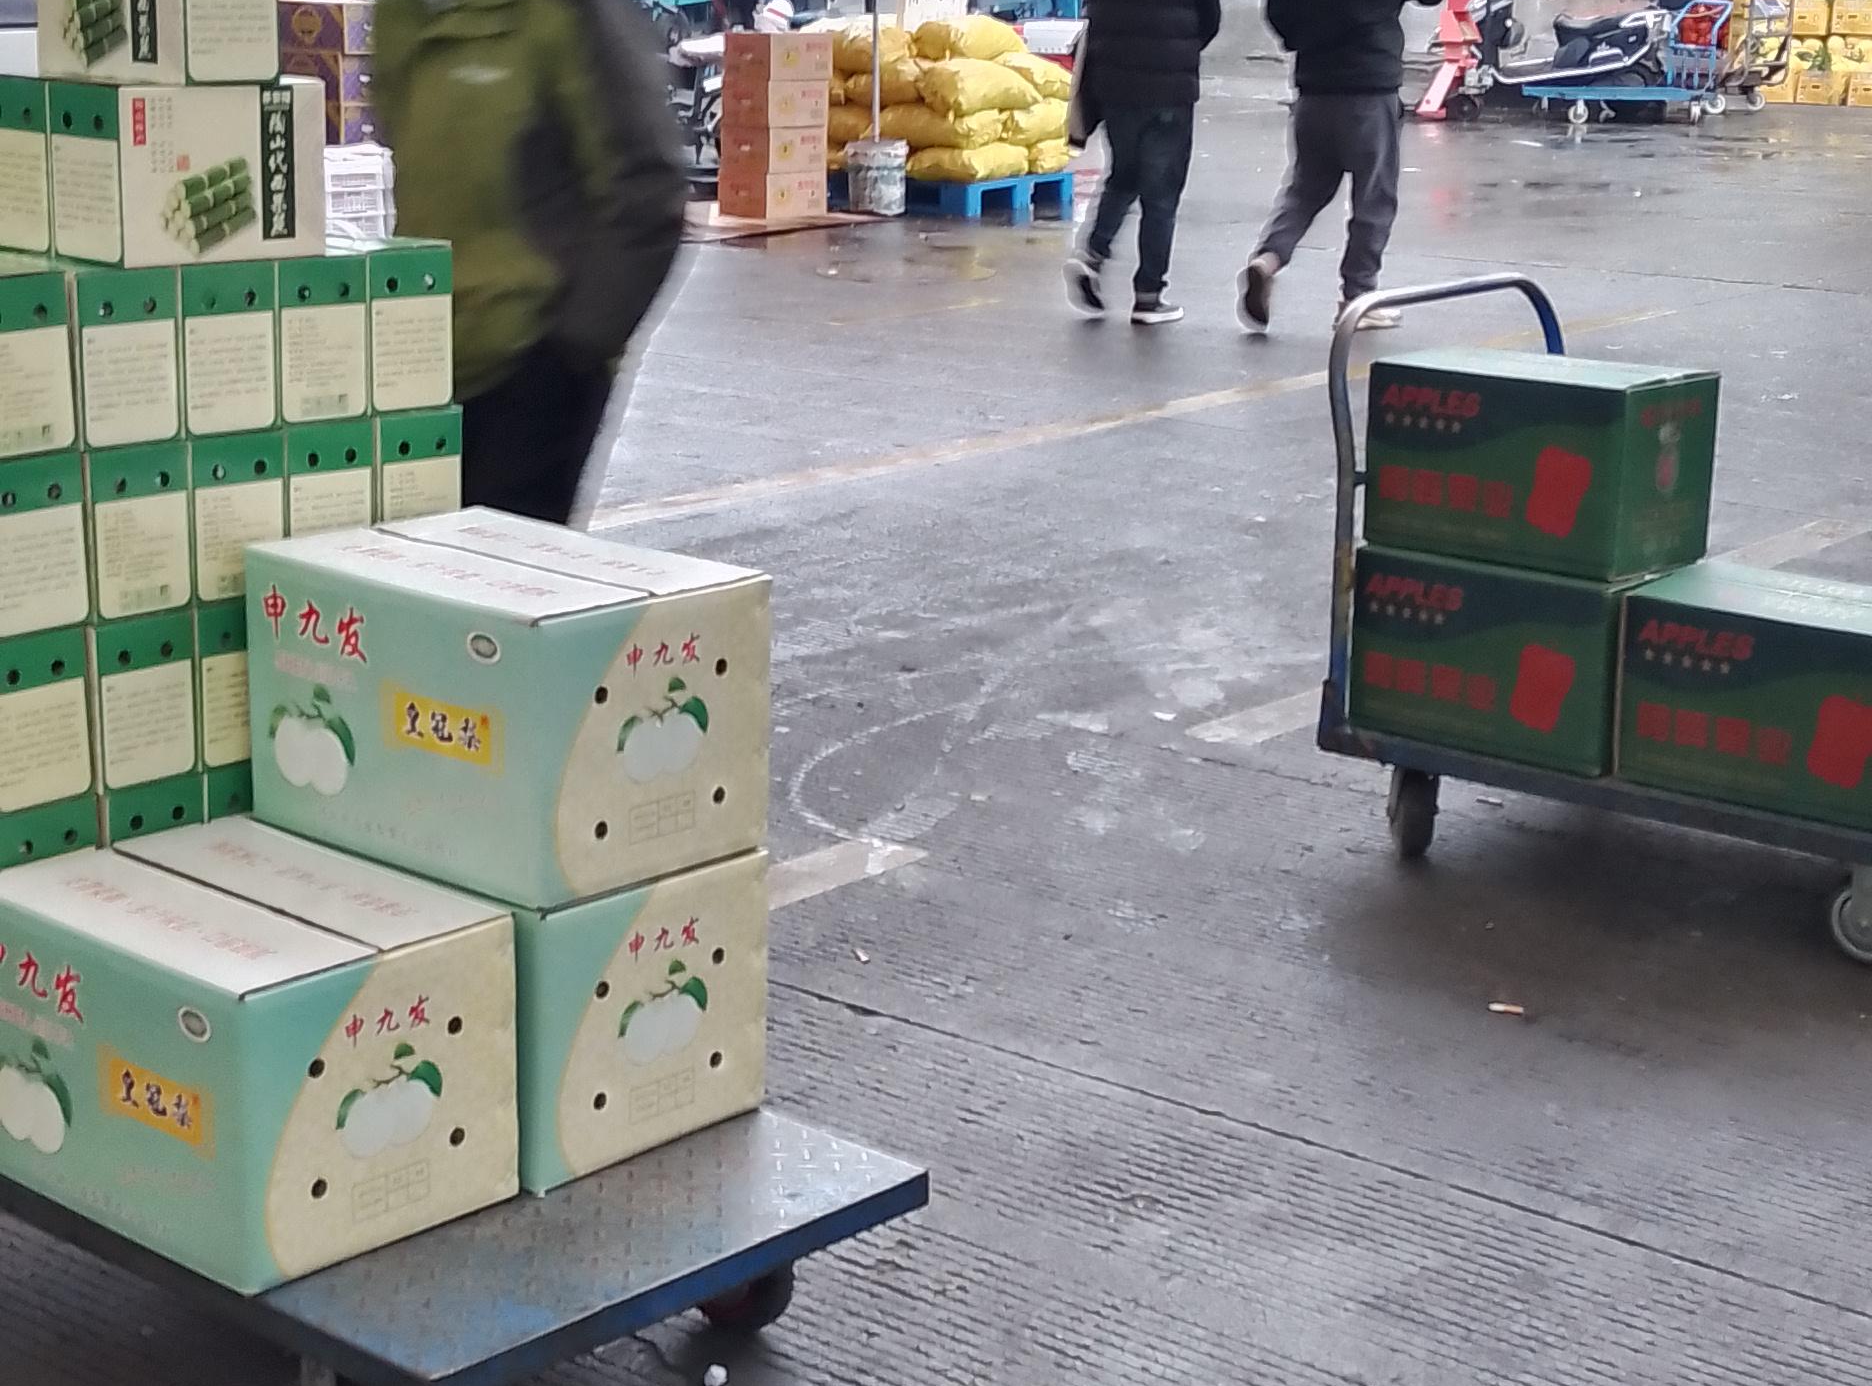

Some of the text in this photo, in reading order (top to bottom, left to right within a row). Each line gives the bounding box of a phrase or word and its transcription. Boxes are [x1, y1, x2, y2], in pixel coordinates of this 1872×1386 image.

[1380, 384, 1482, 419] APPLES
[1367, 573, 1464, 612] APPLES
[263, 583, 368, 664] 申九发
[1639, 618, 1755, 661] APPLES
[626, 632, 701, 677] 申九发
[628, 916, 700, 962] 申九发
[344, 994, 430, 1048] 申九发
